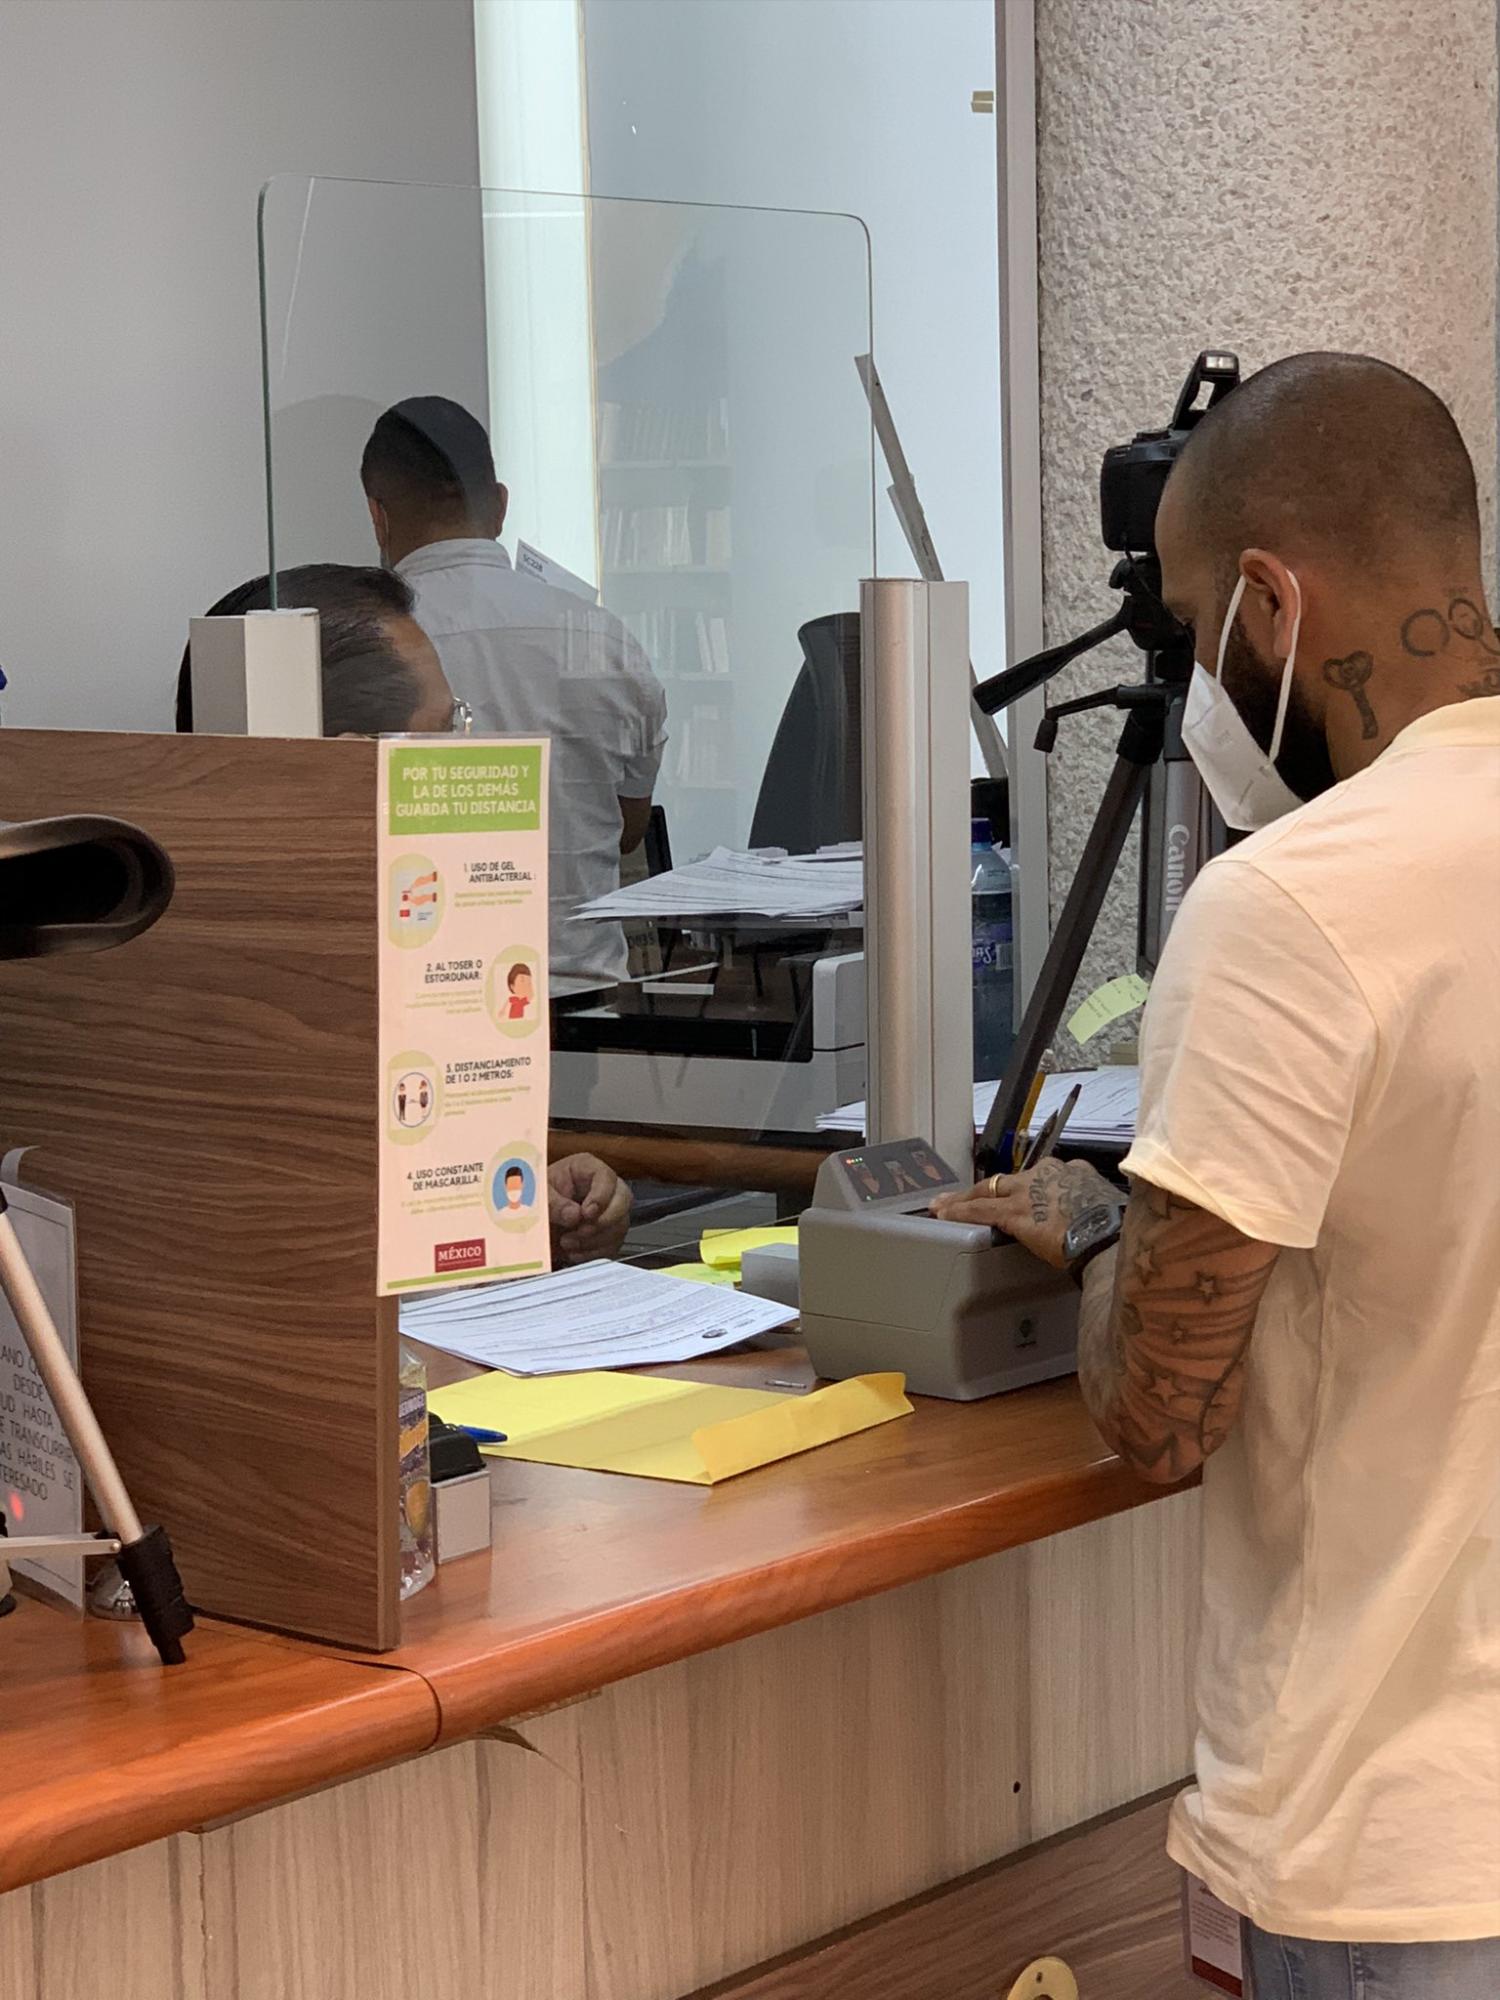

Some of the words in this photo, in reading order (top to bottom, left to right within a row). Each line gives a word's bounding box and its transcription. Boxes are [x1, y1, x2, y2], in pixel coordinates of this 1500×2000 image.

[403, 767, 428, 781] POR
[432, 766, 448, 780] TU
[450, 765, 518, 780] SEGURIDAD
[521, 765, 529, 778] Y
[413, 785, 430, 799] LA
[433, 784, 448, 798] DE
[451, 783, 474, 798] LOS
[396, 802, 449, 817] GUARDA
[453, 801, 468, 815] TU
[470, 799, 536, 815] DISTANCIA
[471, 862, 487, 872] USO
[489, 861, 499, 871] DE
[501, 860, 515, 871] GEL
[1165, 824, 1190, 912] Canon
[435, 961, 446, 972] AL
[448, 959, 474, 971] TOSER
[475, 959, 483, 969] O
[454, 1057, 531, 1073] DISTANCIAMIENTO
[445, 1074, 456, 1084] DE
[472, 1072, 478, 1082] 2
[416, 1168, 433, 1179] USO
[435, 1162, 484, 1177] CONSTANTE
[413, 1181, 423, 1191] DE
[438, 1246, 482, 1262] MÉXICO
[23, 1403, 53, 1428] HASTA
